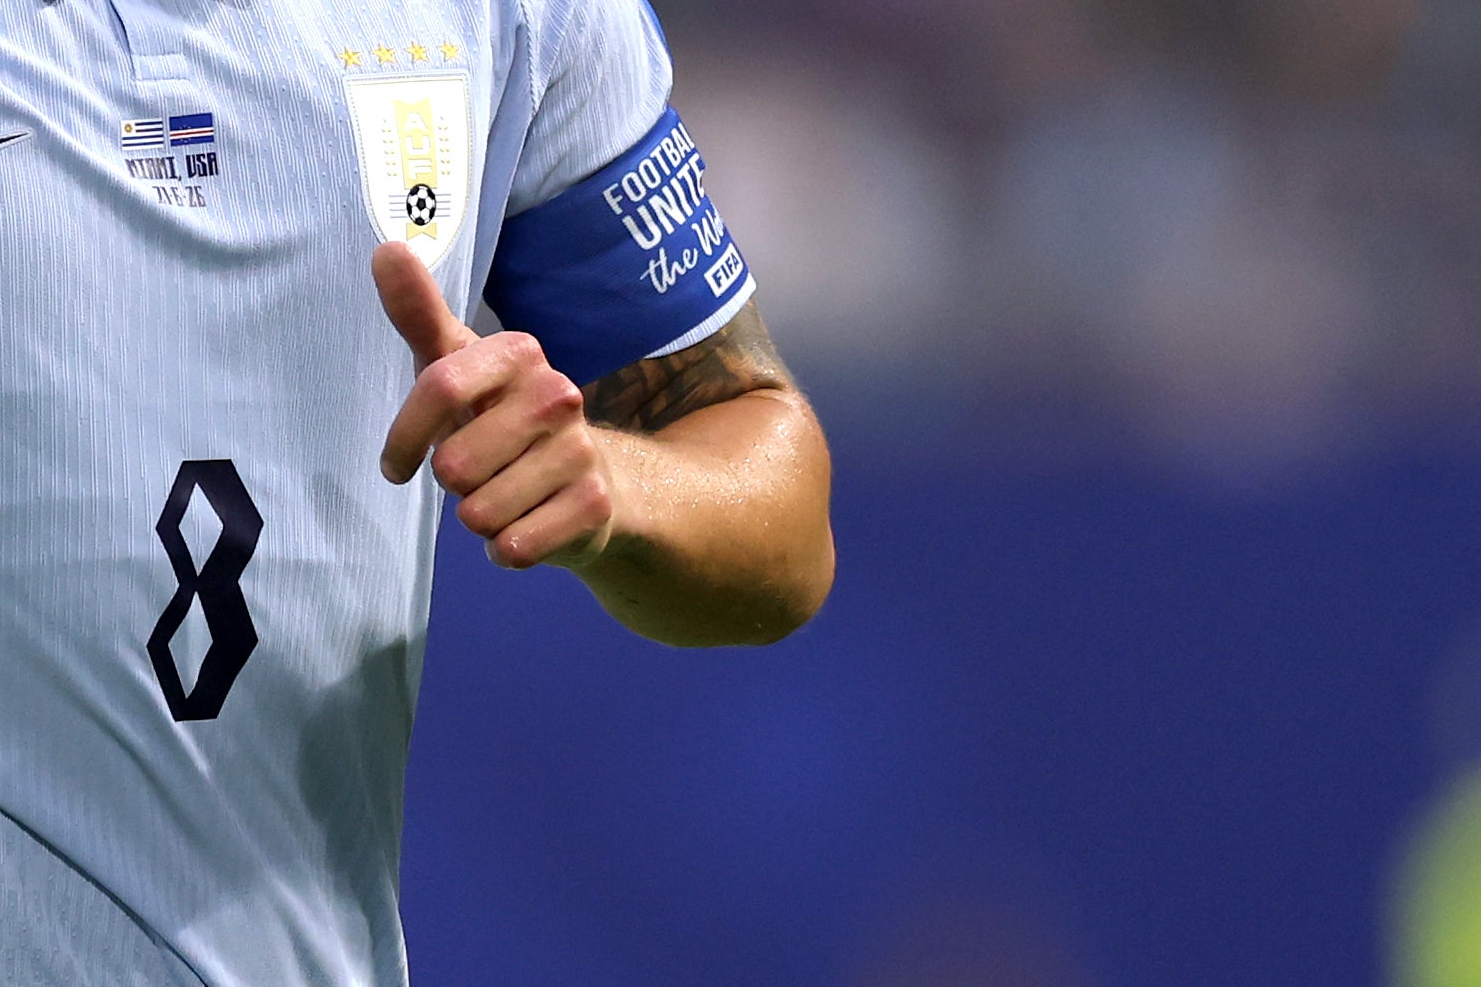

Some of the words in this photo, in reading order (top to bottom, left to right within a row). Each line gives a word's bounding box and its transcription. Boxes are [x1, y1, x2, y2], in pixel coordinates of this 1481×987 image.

[125, 156, 182, 181] MIAMI,
[185, 152, 219, 178] USA
[639, 247, 698, 294] the
[711, 251, 741, 289] FIFA
[146, 459, 264, 722] 8
